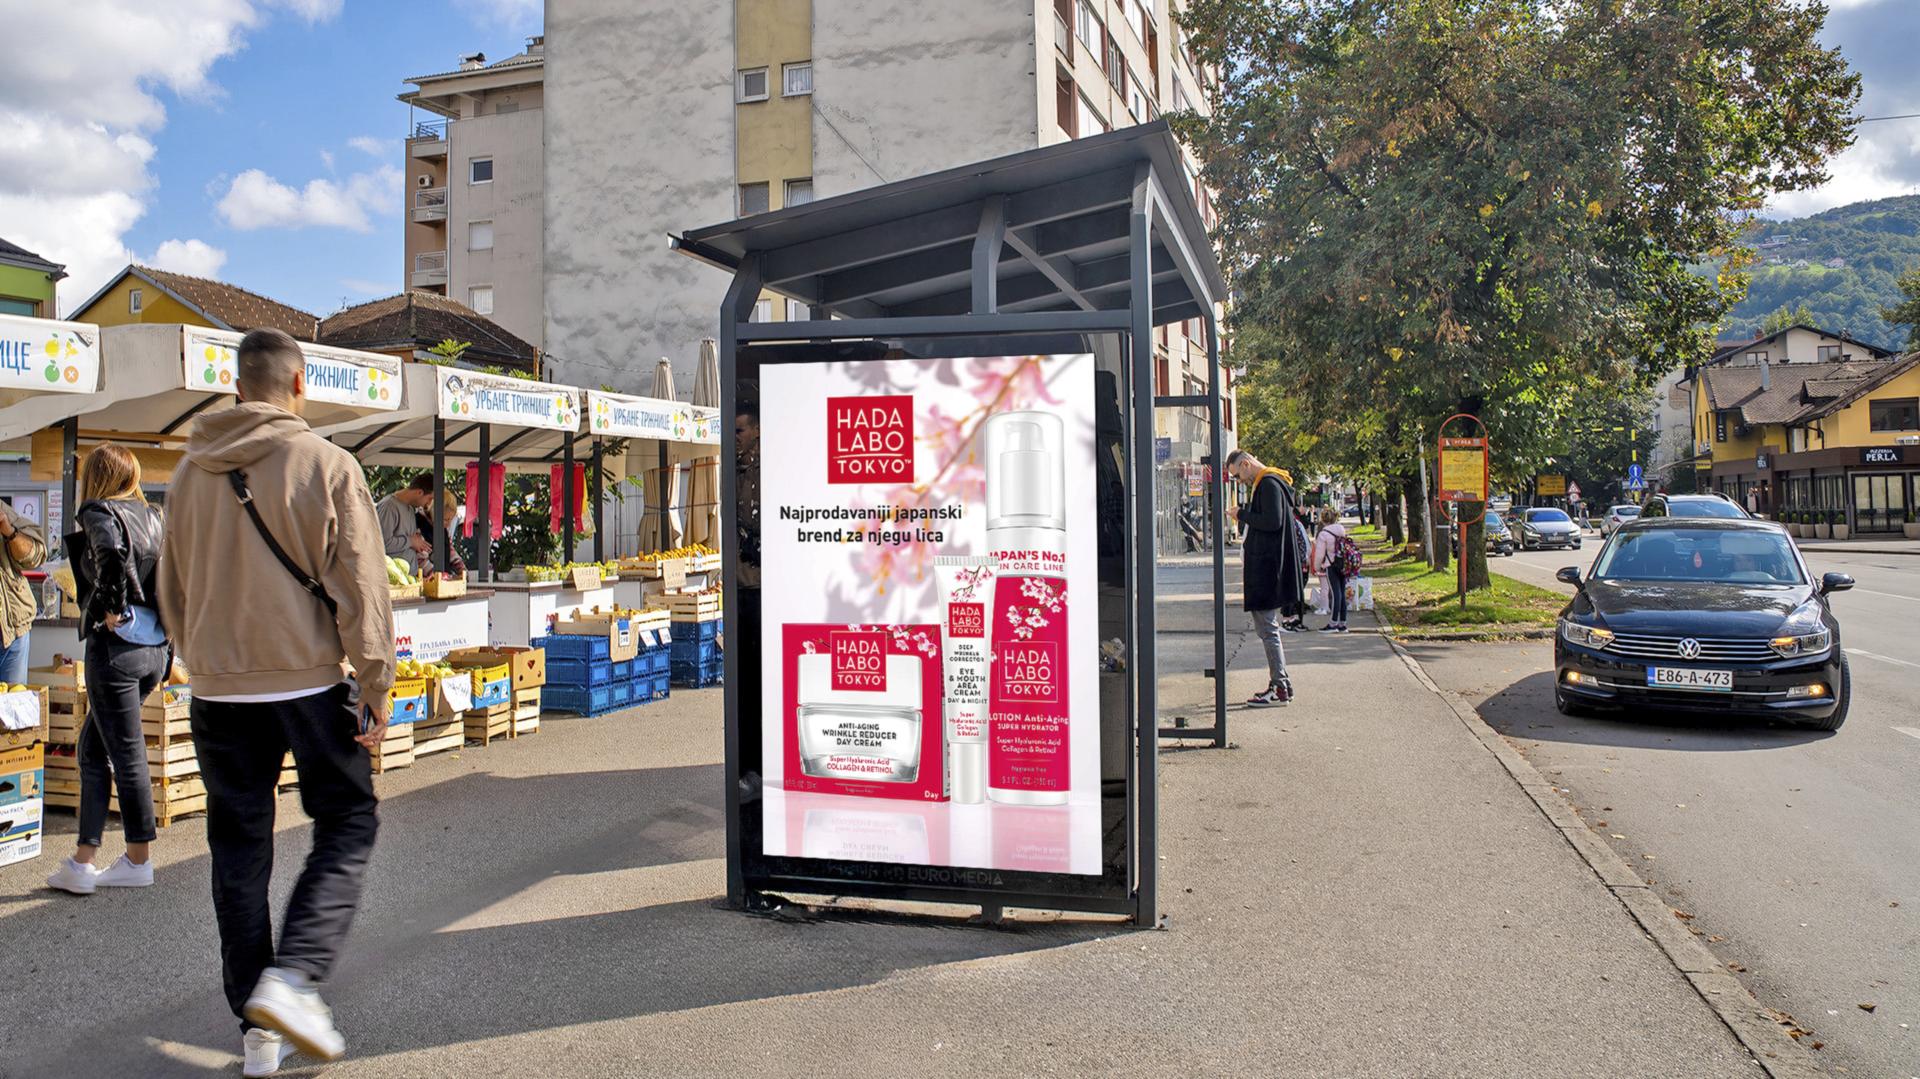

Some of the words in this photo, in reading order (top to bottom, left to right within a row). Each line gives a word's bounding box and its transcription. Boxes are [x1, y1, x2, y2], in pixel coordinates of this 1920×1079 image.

[475, 390, 510, 412] УРБАНЕ
[511, 394, 552, 420] ТРЖНИЦЕ
[613, 407, 639, 427] УРБАНЕ
[640, 411, 670, 431] ТРЖНИЦЕ
[837, 408, 904, 429] HADA
[837, 431, 904, 452] LABO
[1866, 453, 1898, 462] PERLA
[780, 505, 891, 523] Najprodavaniji
[894, 505, 962, 523] japanski
[798, 528, 842, 543] brend
[846, 532, 864, 543] za
[868, 528, 911, 546] njegu
[916, 528, 944, 543] lica
[1042, 551, 1066, 563] No.1
[1013, 562, 1040, 570] CARE
[1043, 563, 1065, 572] LINE
[952, 607, 981, 616] HADA
[952, 617, 981, 625] LABO
[837, 639, 880, 654] HADA
[1004, 650, 1051, 664] HADA
[837, 656, 881, 670] LABO
[1005, 666, 1051, 680] LABO
[1657, 669, 1730, 686] E86-A-473
[957, 682, 978, 690] AREA
[953, 689, 981, 697] CREAM
[988, 713, 1021, 721] LOTION
[838, 722, 880, 731] ANTI-AGING
[822, 729, 857, 738] WRINKLE
[859, 731, 897, 740] REDUCER
[836, 738, 852, 746] DAY
[854, 739, 882, 747] CREAM
[996, 736, 1014, 744] Super
[1014, 737, 1047, 746] Hyaluronic
[1047, 738, 1062, 746] Acid
[1001, 745, 1028, 754] Collagen
[829, 755, 846, 764] Super
[847, 756, 875, 765] Hyaluronic
[827, 762, 859, 771] COLLAGEN
[867, 766, 894, 774] RETINOL
[924, 790, 939, 799] Day
